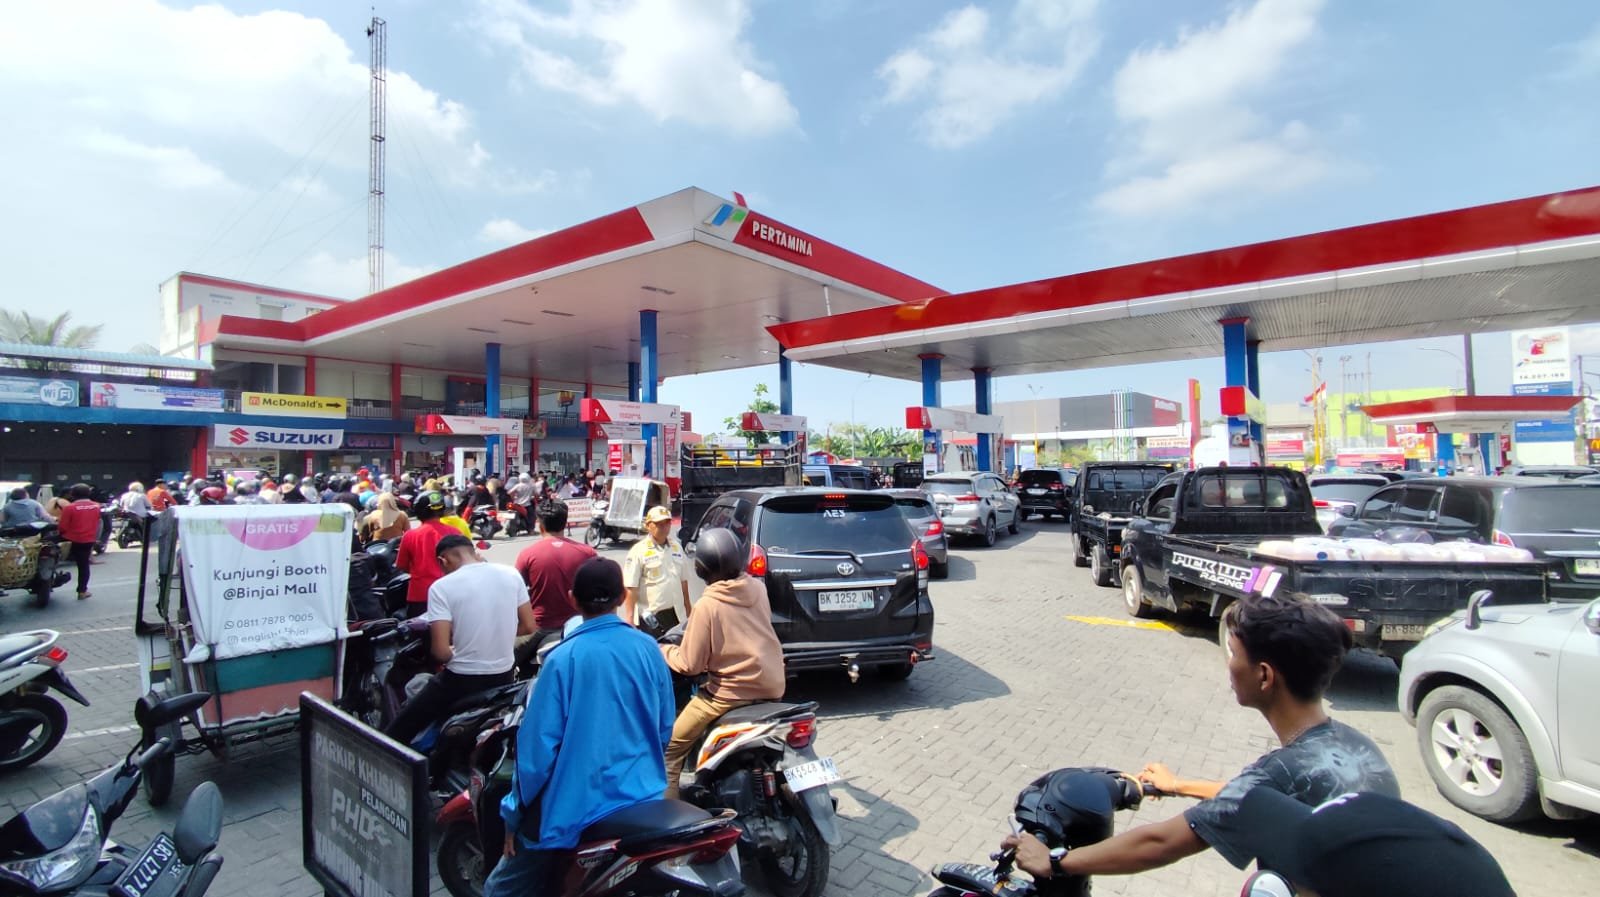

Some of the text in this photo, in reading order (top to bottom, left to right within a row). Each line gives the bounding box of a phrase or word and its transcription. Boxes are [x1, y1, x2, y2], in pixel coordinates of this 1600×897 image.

[752, 220, 813, 257] PERTAMINA
[262, 398, 323, 409] McDonald's
[255, 430, 333, 445] SUZUKI
[246, 522, 298, 534] GRATIS
[213, 564, 327, 582] Kunjungi Booth
[1172, 551, 1253, 580] PICK UP
[1200, 571, 1245, 590] RACING
[223, 583, 317, 600] @Binjai Mall
[820, 588, 873, 605] BK 1252 VN
[237, 619, 259, 628] 0811
[262, 616, 285, 625] 7878
[315, 731, 407, 811] PARKIR KHUSUS
[331, 787, 375, 841] PHD
[361, 787, 408, 834] PELANGGAN
[608, 860, 640, 889] 125
